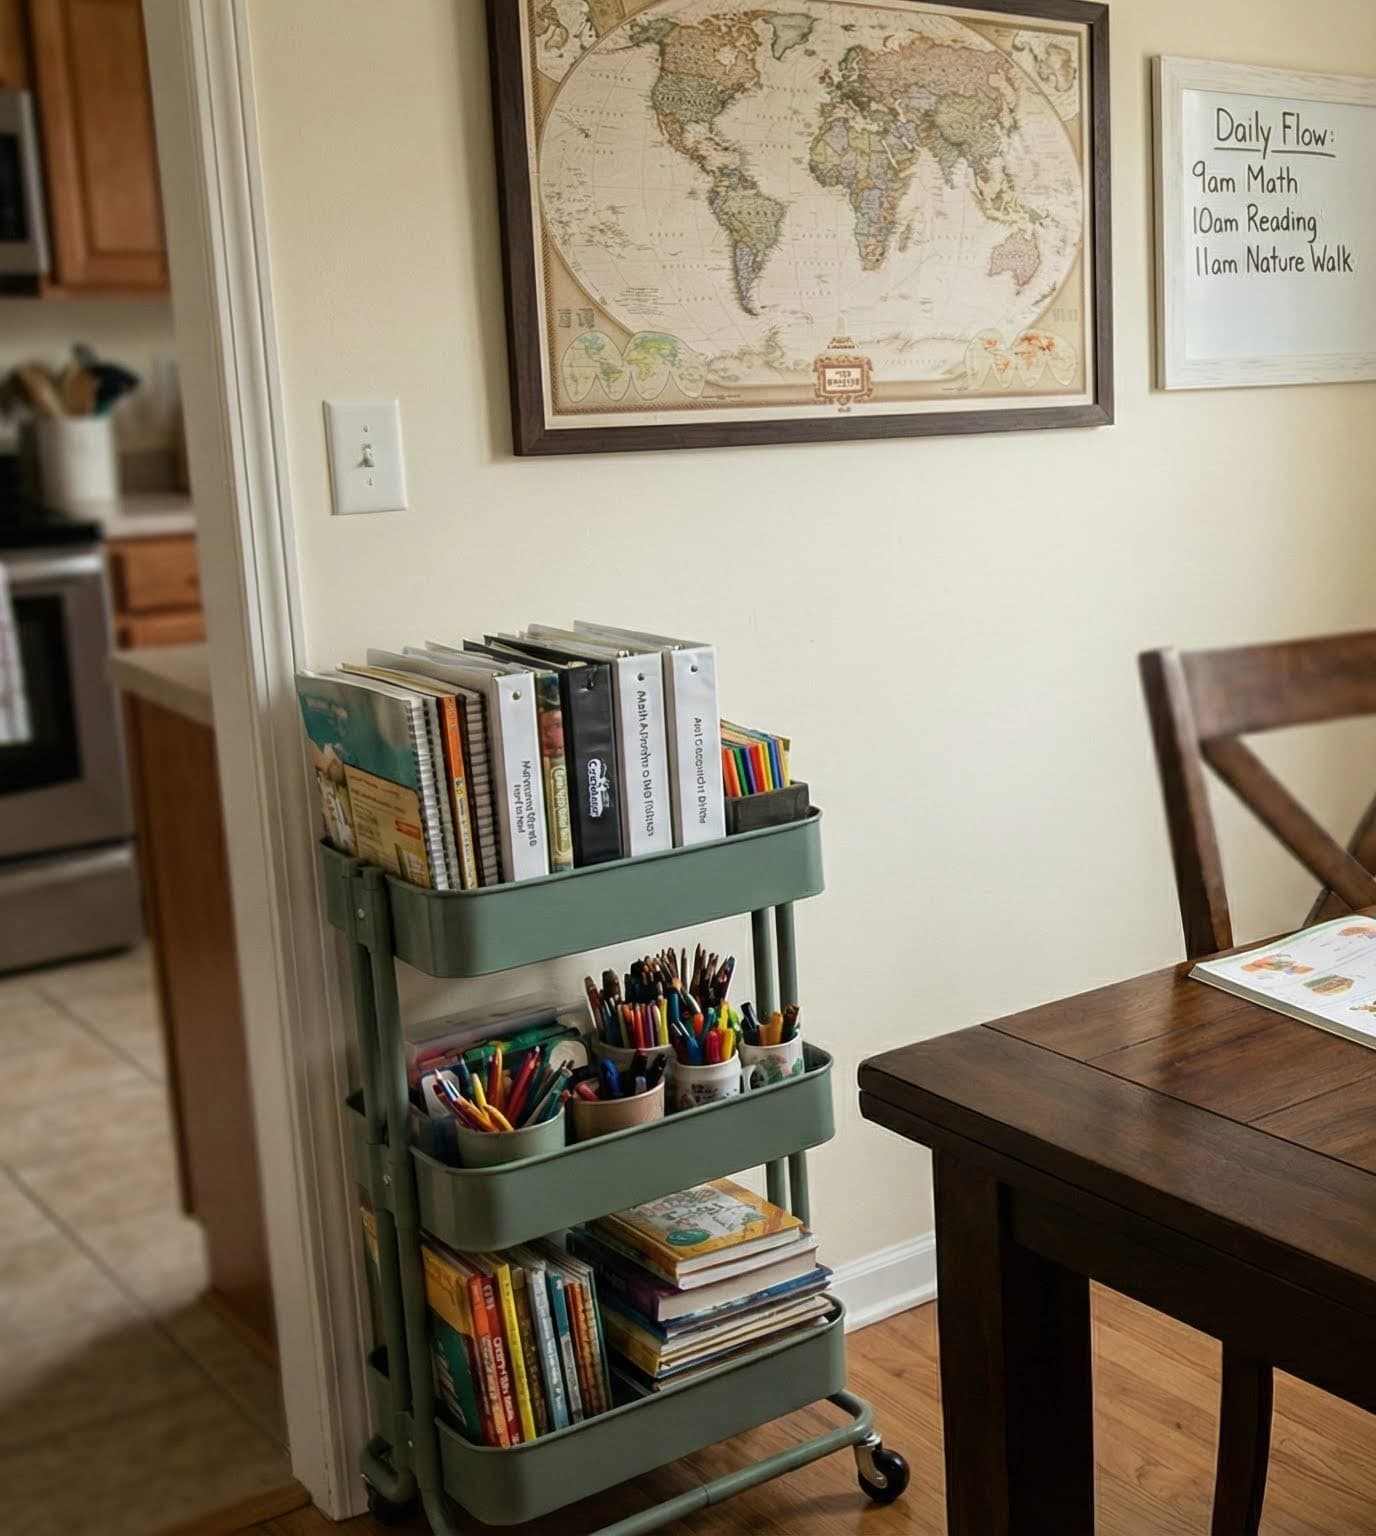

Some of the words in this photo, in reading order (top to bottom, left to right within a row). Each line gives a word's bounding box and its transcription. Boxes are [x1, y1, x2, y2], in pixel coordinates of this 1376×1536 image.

[1216, 107, 1272, 160] Daily
[1282, 111, 1335, 147] Flow:
[1192, 160, 1236, 194] 9am
[1247, 163, 1299, 194] Math
[1193, 206, 1239, 234] 10am
[1246, 203, 1317, 244] Reading
[1196, 246, 1238, 277] 11am
[1246, 244, 1305, 273] Nature
[1310, 244, 1354, 273] Walk
